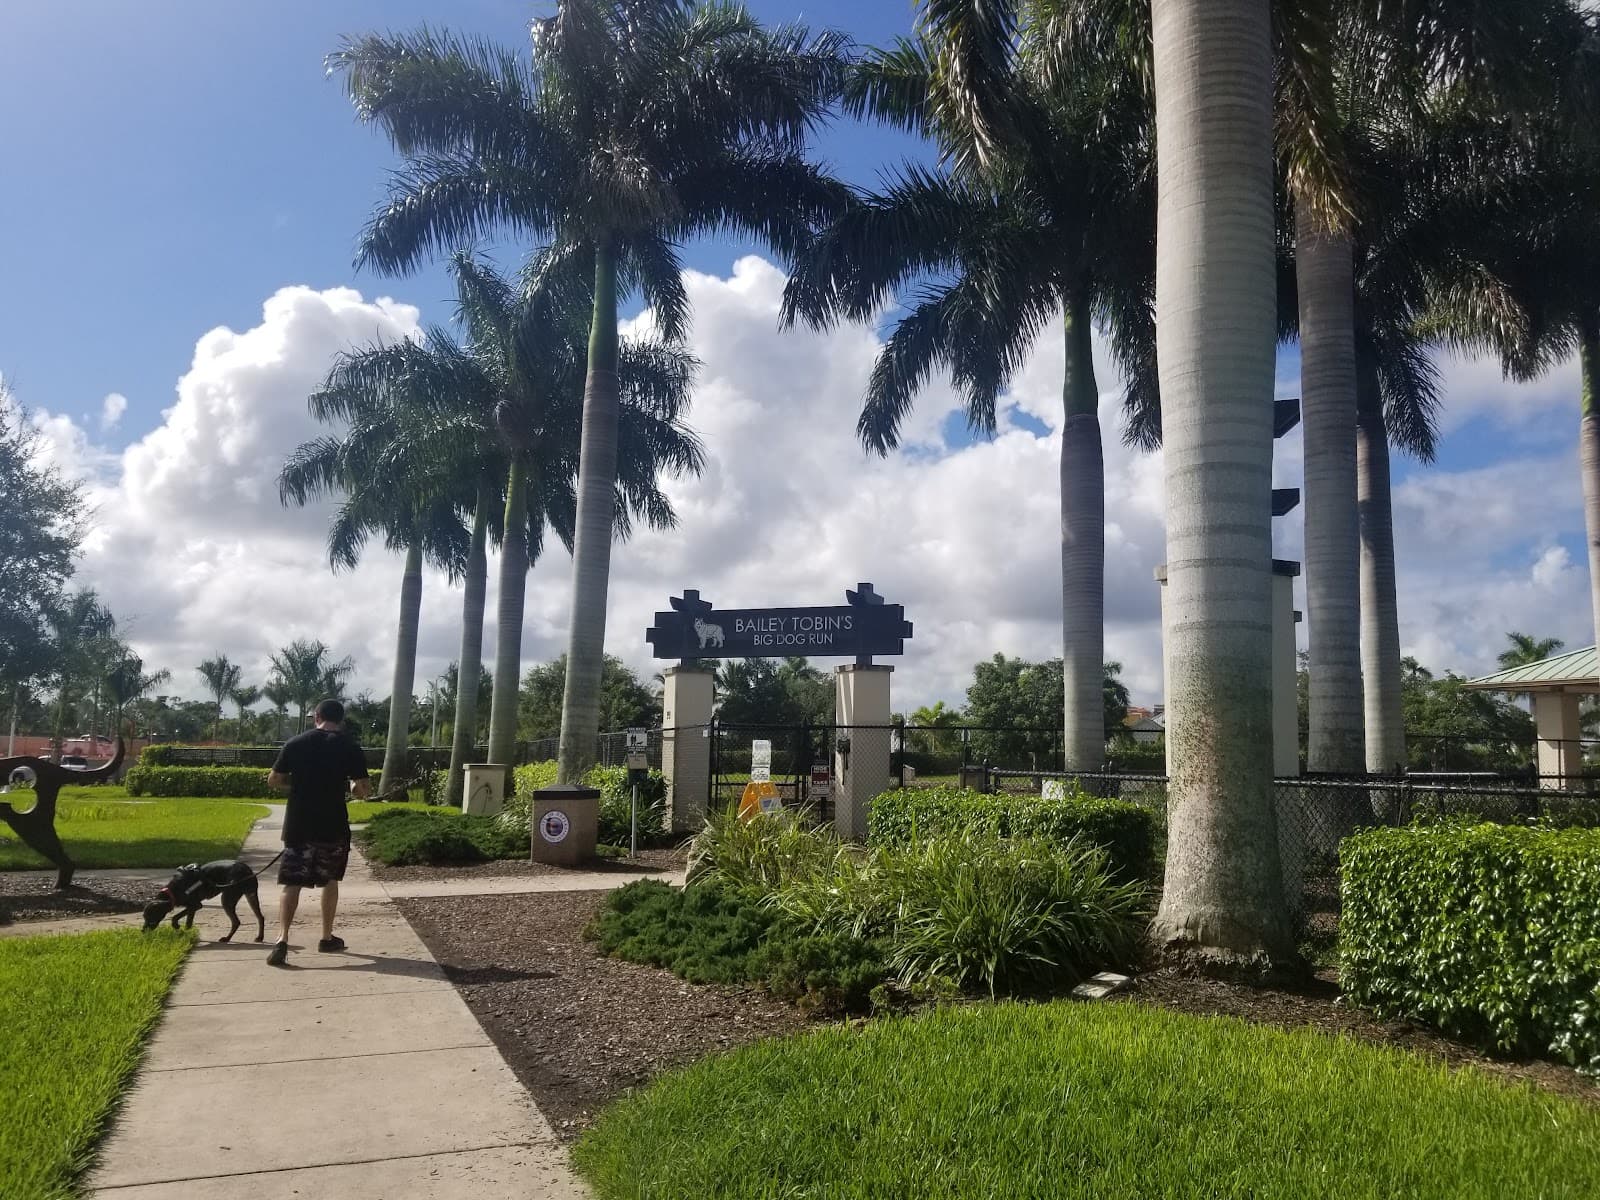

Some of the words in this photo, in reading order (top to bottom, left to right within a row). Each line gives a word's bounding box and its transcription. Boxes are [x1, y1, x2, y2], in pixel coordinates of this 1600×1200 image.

[735, 617, 787, 633] BAILEY
[792, 615, 853, 631] TOBIN'S
[753, 634, 773, 646] BIG
[776, 634, 806, 646] DOG
[809, 633, 833, 645] RUN
